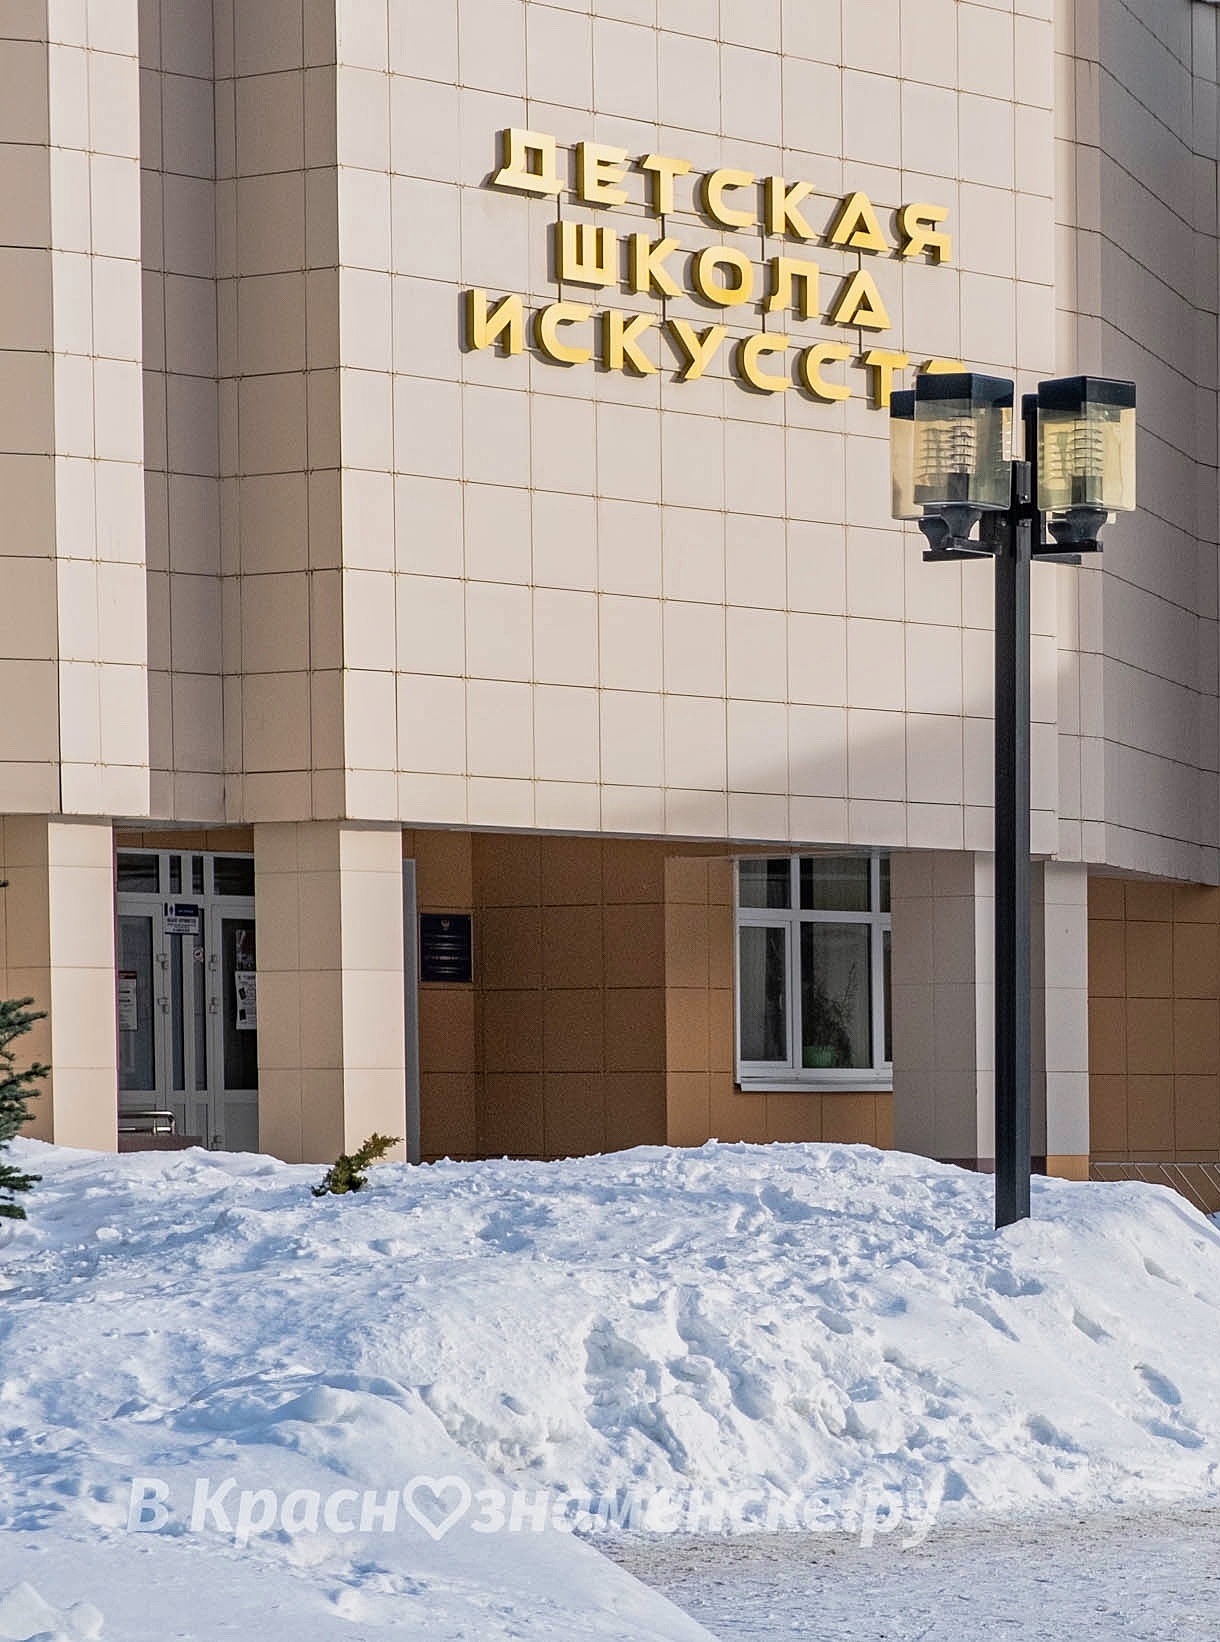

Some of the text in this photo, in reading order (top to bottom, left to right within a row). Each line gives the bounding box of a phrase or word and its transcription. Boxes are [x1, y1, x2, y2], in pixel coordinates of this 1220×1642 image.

[494, 127, 952, 263] ДЕТСКАЯ
[554, 221, 892, 330] ШКОЛА
[467, 288, 968, 408] ИСКУССТ
